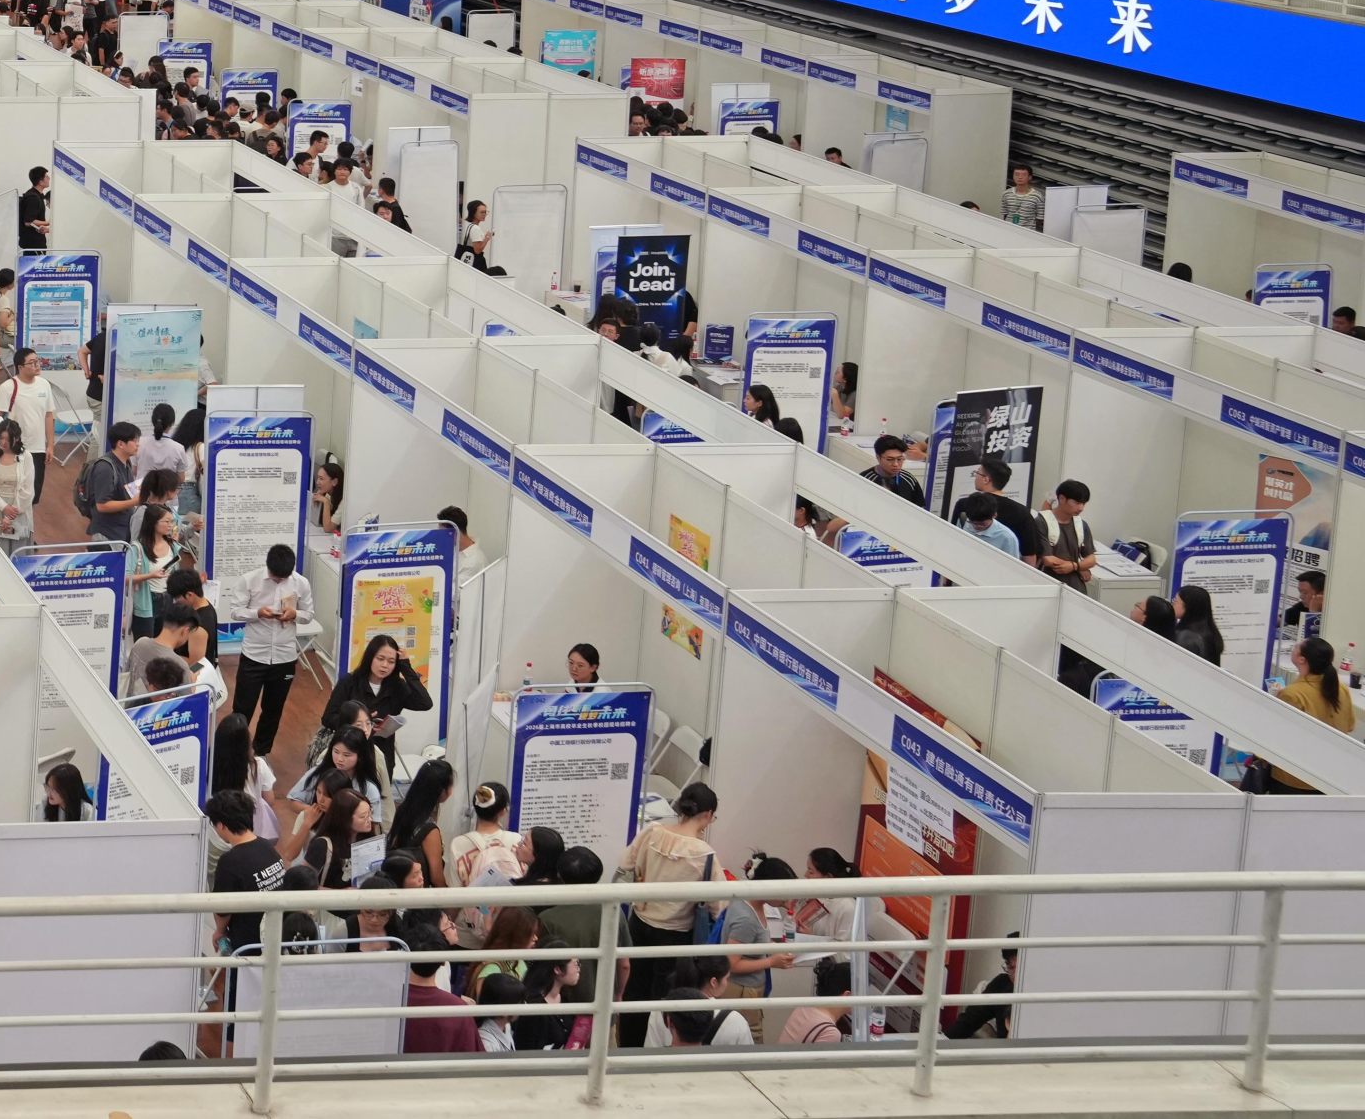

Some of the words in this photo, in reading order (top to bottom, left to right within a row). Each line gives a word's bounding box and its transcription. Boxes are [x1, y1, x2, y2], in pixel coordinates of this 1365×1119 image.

[629, 262, 670, 277] Join
[629, 278, 675, 292] Lead
[987, 311, 999, 325] C061
[1080, 347, 1094, 363] C062
[988, 402, 1032, 428] 绿山
[1228, 406, 1245, 422] C063
[446, 420, 456, 437] C039
[987, 425, 1033, 455] 投资
[518, 469, 530, 489] C040
[532, 478, 588, 528] 中银消费金融有限公司
[635, 549, 649, 572] C041
[734, 617, 750, 641] C042
[753, 630, 832, 698] 中国工商银行股份有限公司
[901, 730, 920, 759] C043
[925, 747, 1026, 831] 建信融通有限责任公司
